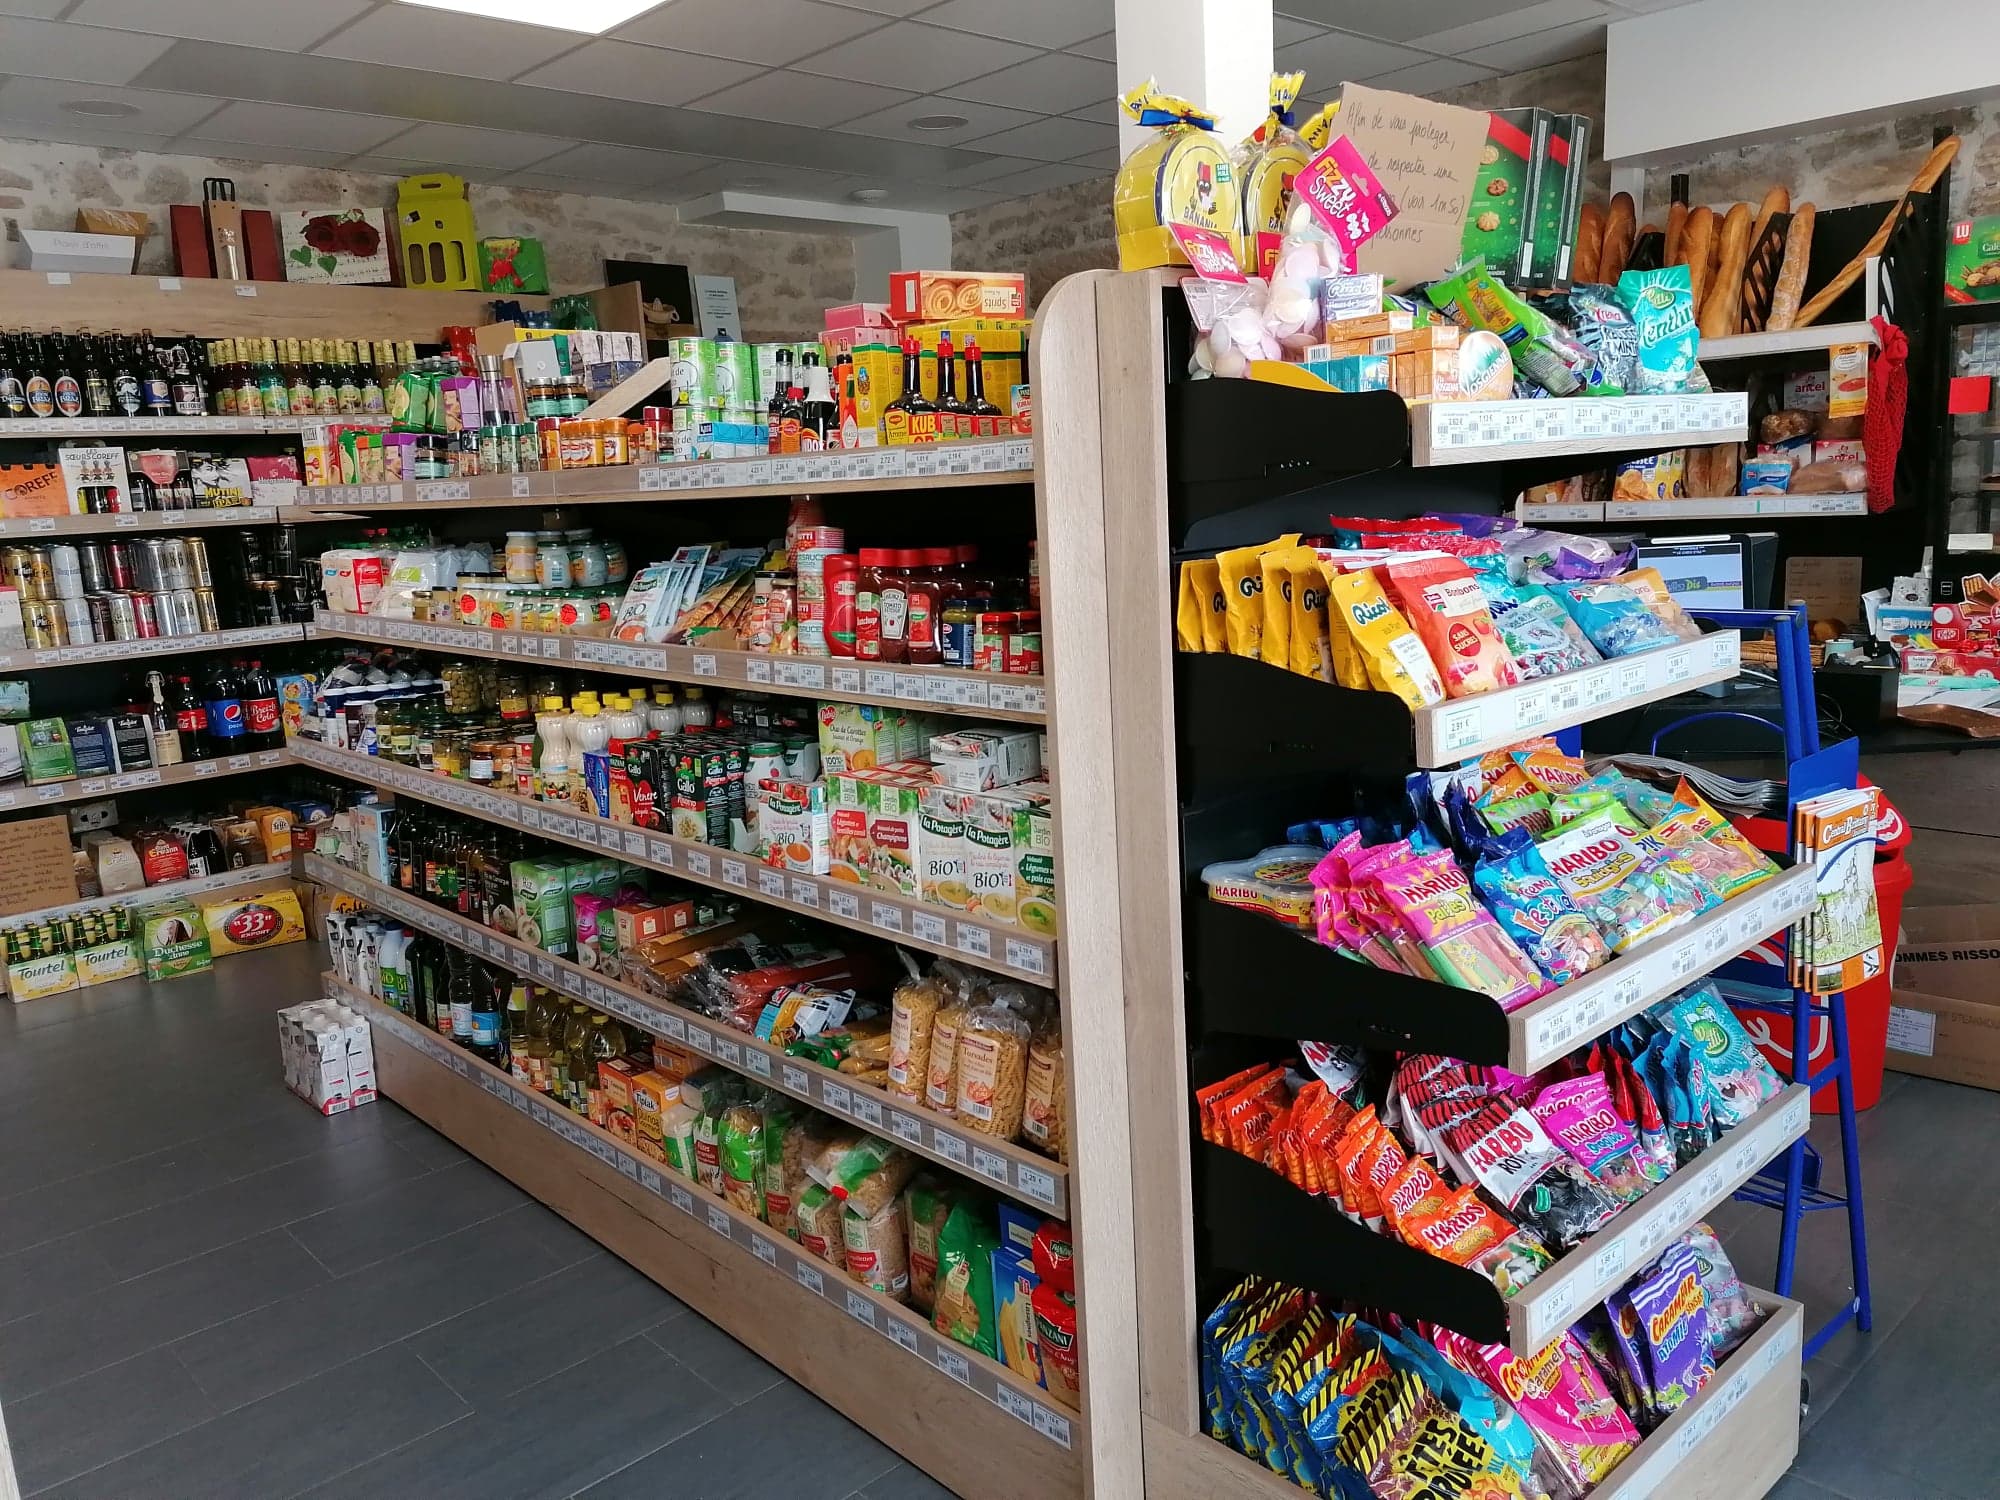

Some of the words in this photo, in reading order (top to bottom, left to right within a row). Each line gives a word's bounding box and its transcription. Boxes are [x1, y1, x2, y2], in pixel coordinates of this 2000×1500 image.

[1956, 225, 1970, 239] LU
[1795, 383, 1825, 394] ancel
[912, 415, 937, 433] KUB
[1445, 582, 1480, 597] Bonbons
[252, 702, 276, 716] Breizh
[257, 712, 275, 723] Cola
[628, 763, 642, 775] Gallo
[708, 767, 723, 775] Gallo
[1530, 765, 1586, 786] HARIBO
[634, 788, 658, 803] Venere
[677, 779, 696, 794] Gallo
[931, 820, 963, 836] Potagère
[977, 830, 1010, 848] Potagère
[1550, 839, 1623, 878] HARIBO
[1216, 885, 1258, 899] HARIBO
[1401, 870, 1470, 906] HARIBO
[83, 945, 130, 966] Tourtel
[153, 940, 204, 958] Duchesse
[1895, 951, 1950, 963] OMMES
[1952, 949, 2000, 961] RISSO
[18, 959, 66, 980] Tourtel
[1559, 1109, 1617, 1147] HARIBO
[1469, 1120, 1534, 1174] HARIBO
[1389, 1168, 1433, 1218] HARIBO
[1421, 1203, 1487, 1249] HARIBO
[1651, 1273, 1696, 1344] CARAMBAR
